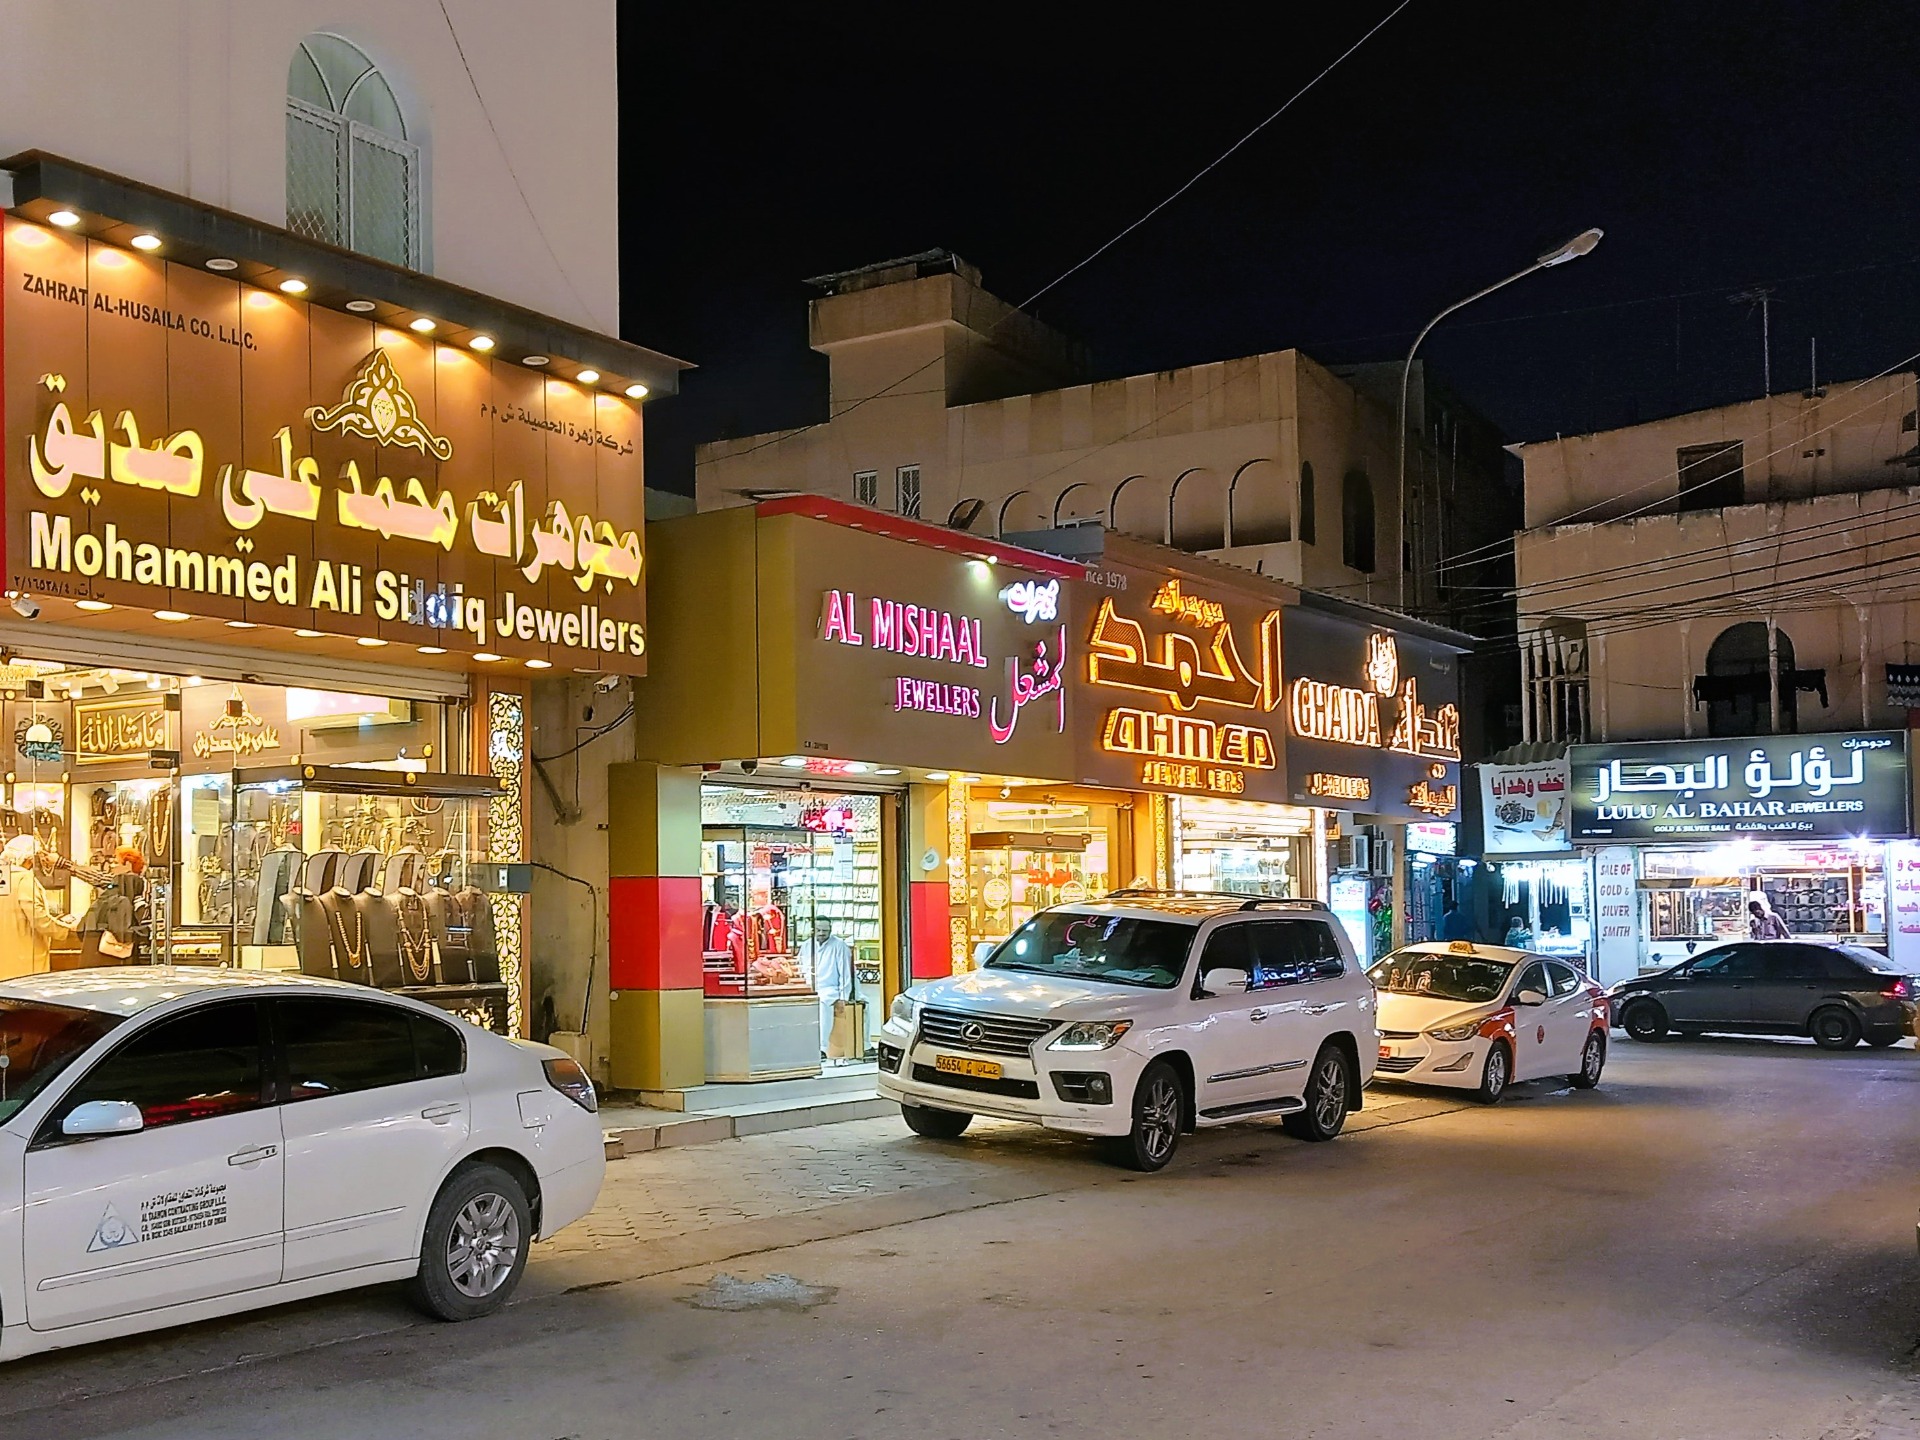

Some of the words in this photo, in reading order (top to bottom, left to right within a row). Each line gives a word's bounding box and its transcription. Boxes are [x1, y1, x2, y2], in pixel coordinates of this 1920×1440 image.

[23, 273, 88, 306] ZAHRAT
[94, 293, 185, 331] AL-HUSAILA
[190, 318, 214, 339] CO.
[518, 408, 566, 434] الحصيلة
[29, 373, 204, 505] صديق
[568, 423, 594, 446] زهرة
[594, 431, 633, 455] شركة
[220, 426, 322, 554] علي
[338, 460, 458, 551] محمد
[466, 480, 643, 595] مجوهرات
[30, 511, 297, 606] Mohammed
[309, 560, 362, 615] Ali
[375, 570, 486, 645] Siddiq
[496, 592, 645, 656] Jewellers
[1106, 571, 1127, 590] 1978
[824, 590, 862, 645] AL
[872, 598, 988, 667] MISHAAL
[895, 677, 981, 718] JEWELLERS
[1292, 677, 1382, 747] GHAIDA
[1103, 707, 1276, 769] AHMED
[1841, 738, 1892, 749] مجوهرات
[1590, 754, 1729, 803] البحار
[1744, 746, 1864, 798] لؤلؤ
[1491, 776, 1534, 800] وهدايا
[1597, 804, 1658, 820] LULU
[1662, 803, 1695, 819] AL
[1700, 800, 1785, 818] BAHAR
[1788, 800, 1864, 814] JEWELLERS
[1654, 825, 1674, 833] GOLD
[1711, 824, 1730, 832] SALE
[1797, 821, 1814, 831] بيع
[1600, 864, 1619, 875] SALE
[1620, 863, 1631, 875] OF
[1600, 884, 1622, 896] GOLD
[1602, 905, 1629, 917] SILVER
[1603, 925, 1631, 937] SMITH
